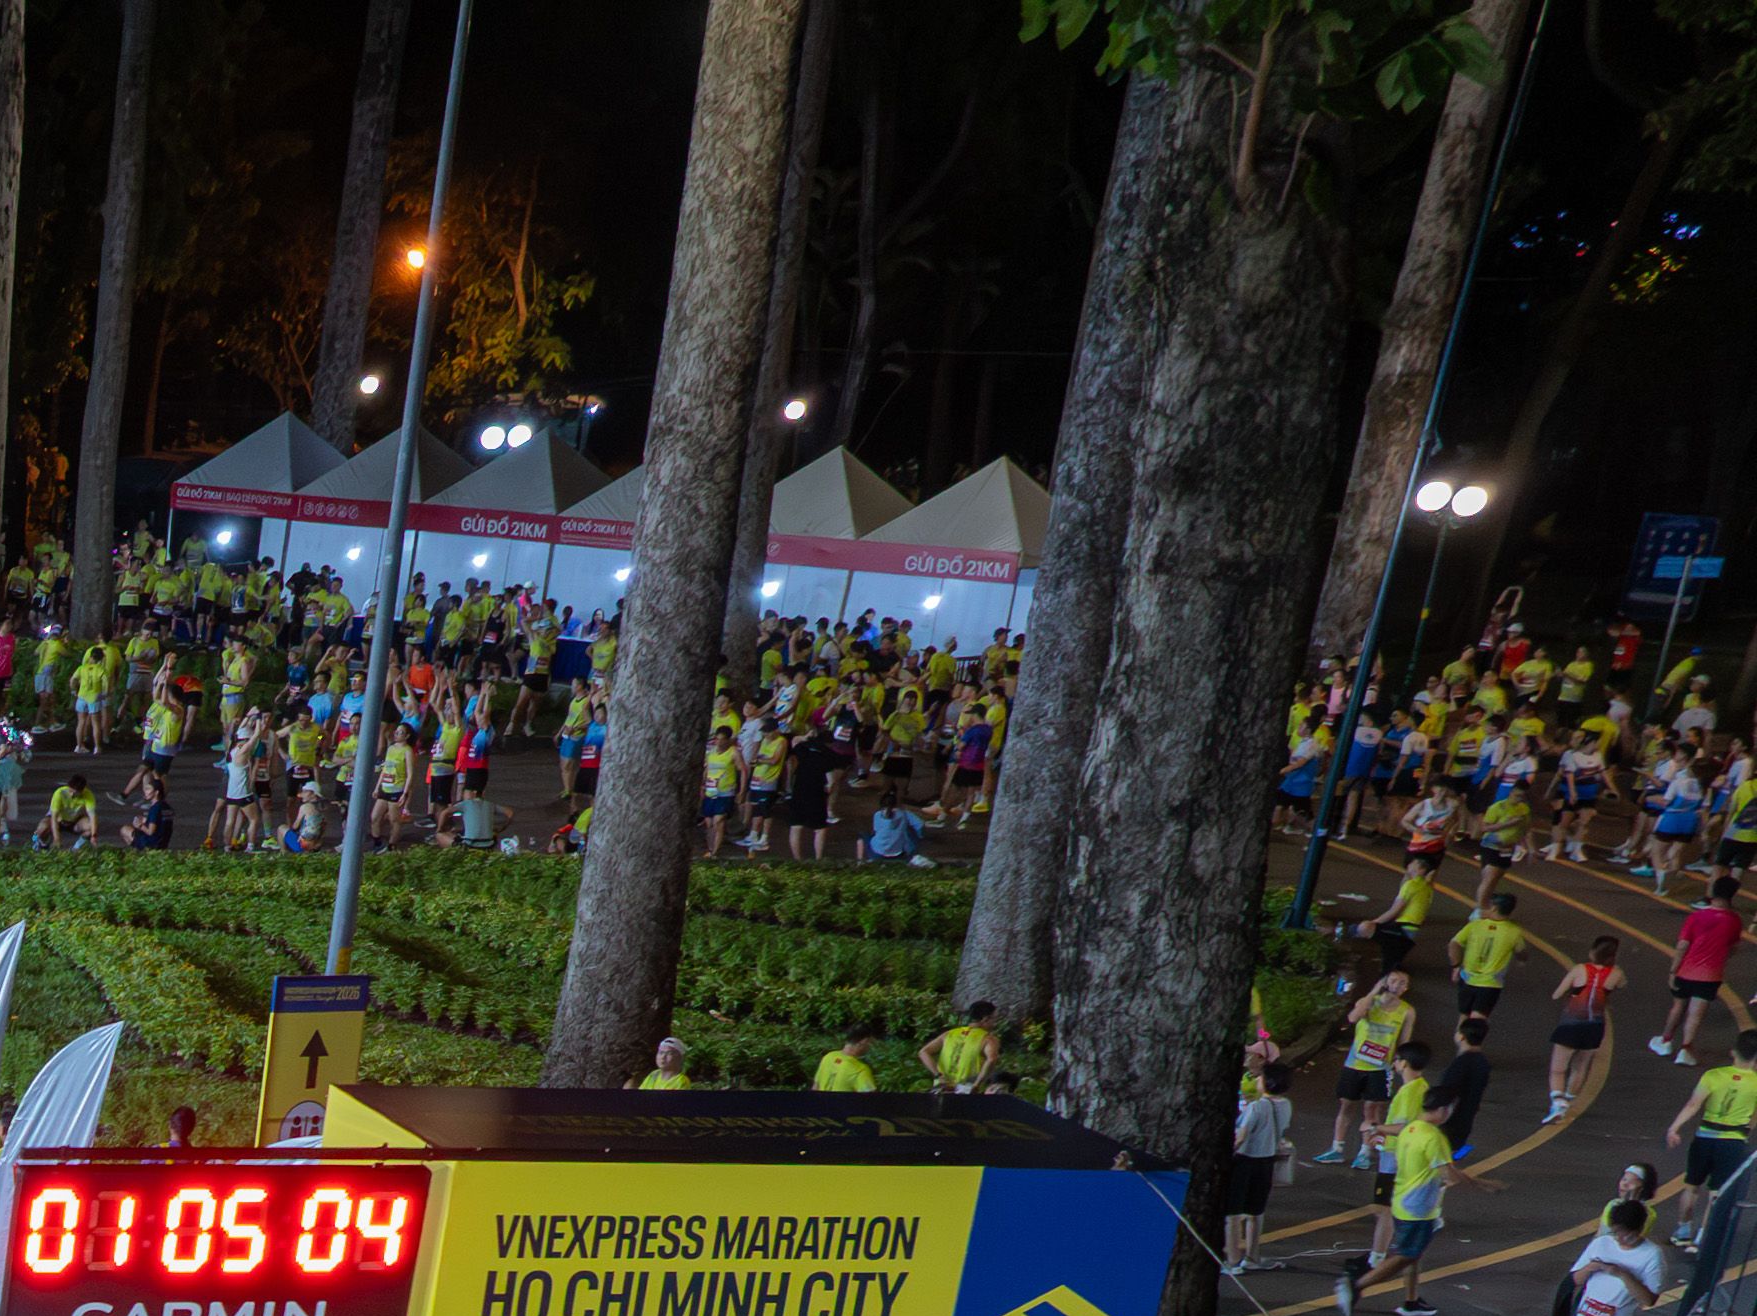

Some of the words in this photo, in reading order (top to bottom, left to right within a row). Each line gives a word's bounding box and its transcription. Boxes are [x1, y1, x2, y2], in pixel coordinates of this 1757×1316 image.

[461, 513, 484, 533] GỬI
[487, 515, 509, 535] ĐỒ
[511, 522, 548, 539] 21KM
[905, 551, 934, 574] GỬI
[937, 554, 963, 576] ĐỒ
[965, 560, 1011, 579] 21KM
[24, 1188, 135, 1273] 01
[161, 1188, 268, 1273] 05
[296, 1188, 408, 1273] 04
[494, 1216, 706, 1261] VNEXPRESS
[713, 1216, 919, 1261] MARATHON
